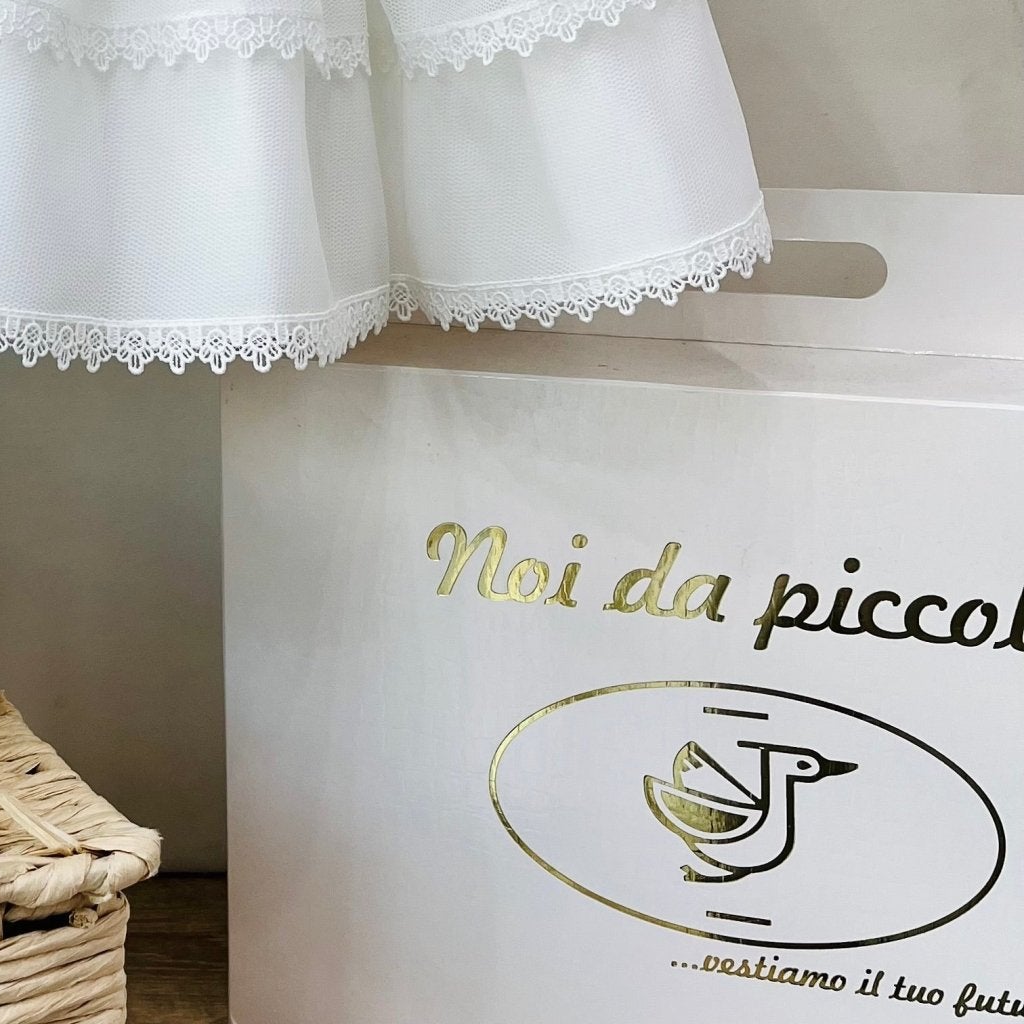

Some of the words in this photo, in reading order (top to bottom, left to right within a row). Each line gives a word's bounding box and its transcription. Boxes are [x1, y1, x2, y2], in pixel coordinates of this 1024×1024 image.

[426, 521, 588, 608] Noi
[602, 541, 731, 623] da
[855, 968, 885, 997] il
[888, 976, 944, 1006] tuo
